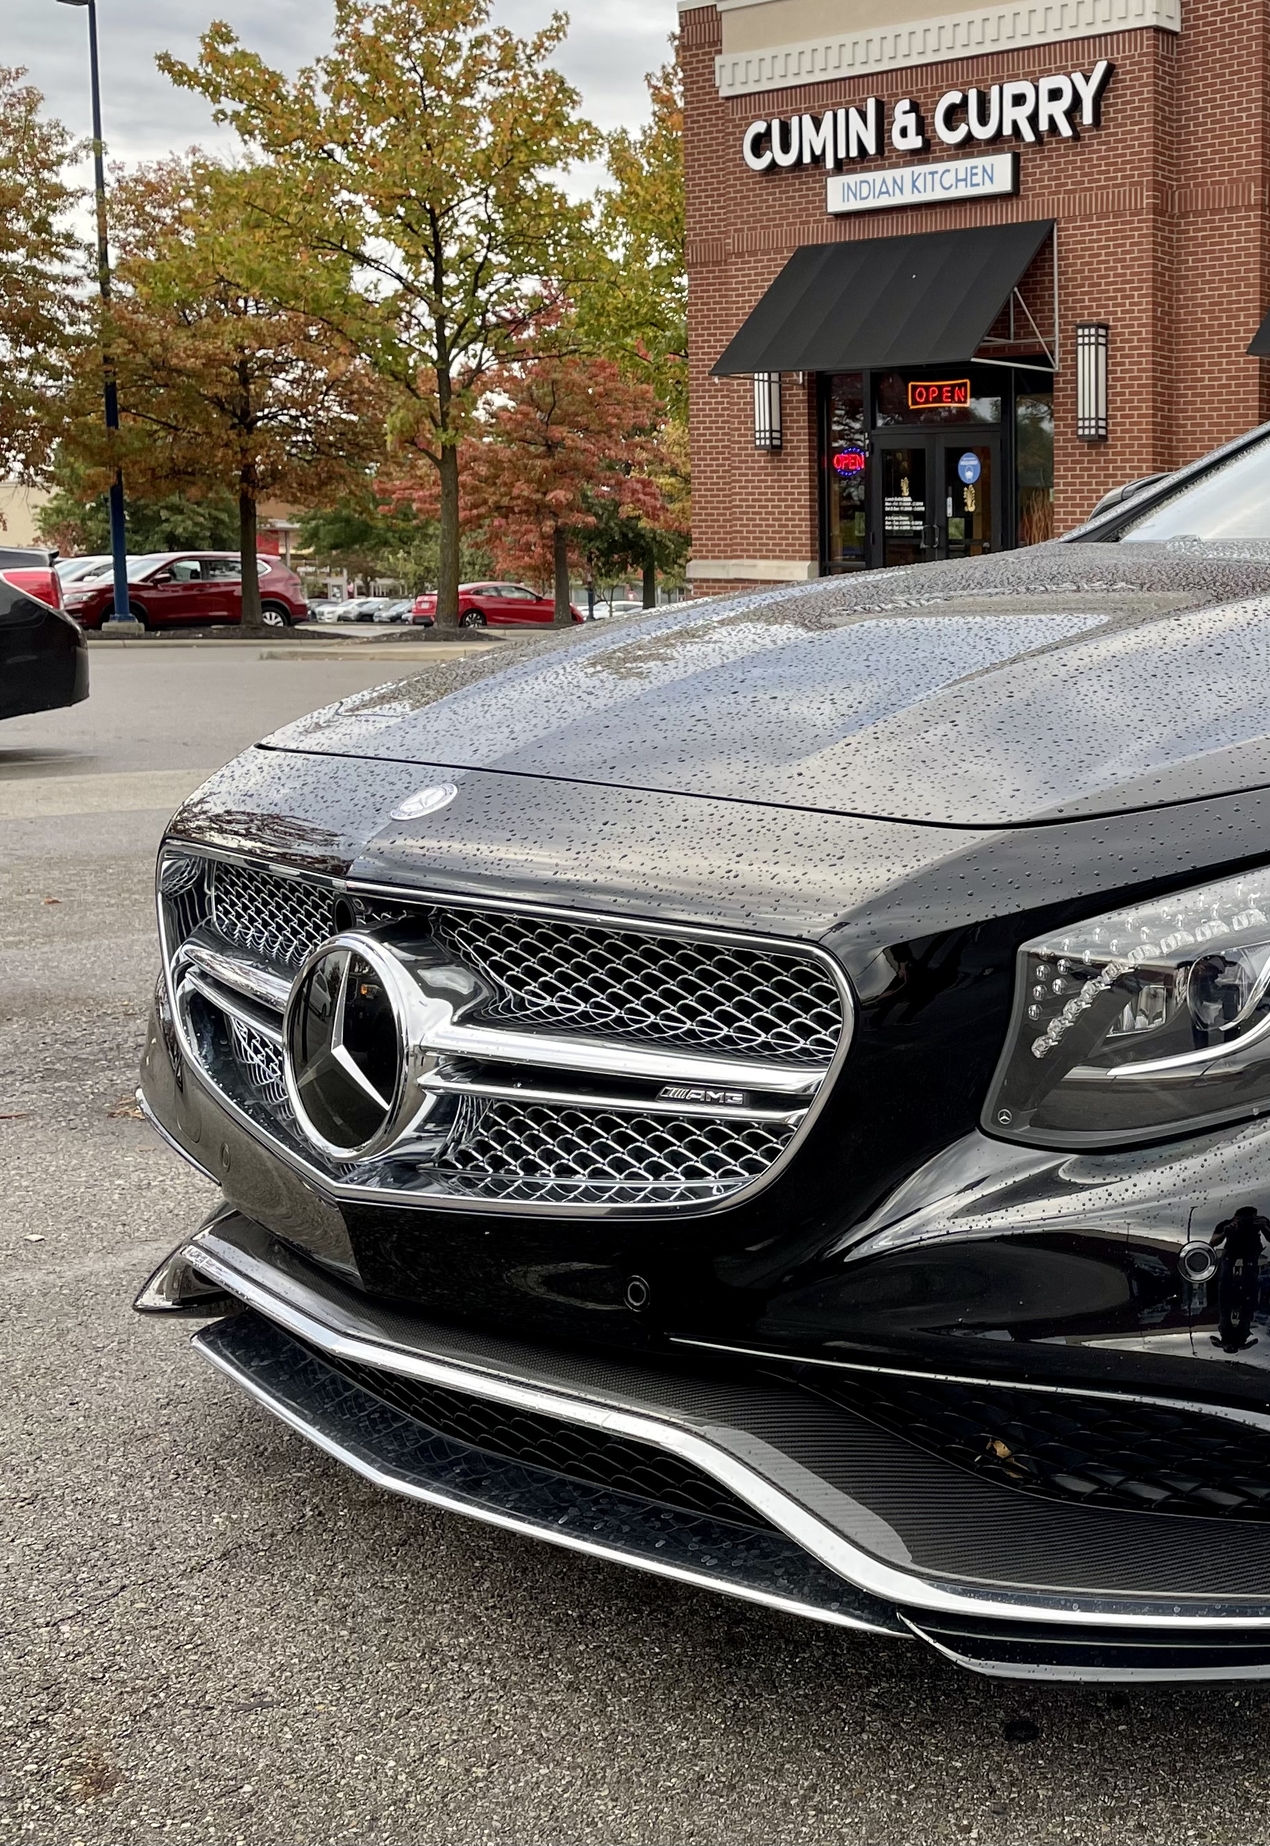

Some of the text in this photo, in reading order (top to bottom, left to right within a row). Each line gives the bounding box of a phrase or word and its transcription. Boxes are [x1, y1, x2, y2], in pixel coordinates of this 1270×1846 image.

[743, 60, 1110, 171] CUMIN & CURRY
[842, 163, 995, 203] INDIAN KITCHEN
[915, 386, 965, 402] OPEN
[833, 453, 865, 469] OPEN
[684, 1088, 743, 1105] AMG
